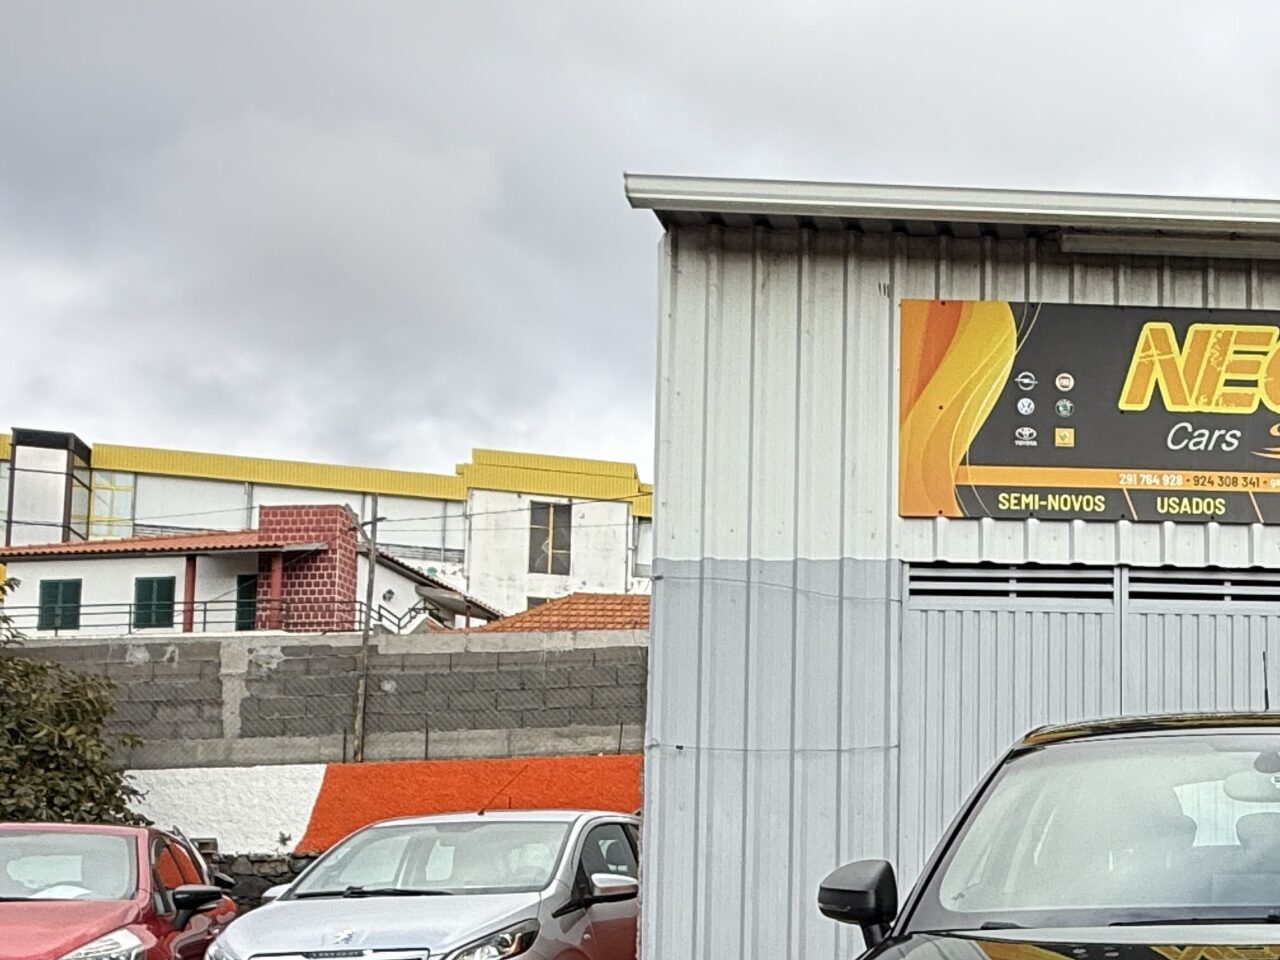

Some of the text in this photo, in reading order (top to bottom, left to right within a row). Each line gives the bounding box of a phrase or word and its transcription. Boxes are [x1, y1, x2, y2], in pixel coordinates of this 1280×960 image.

[1167, 422, 1241, 451] Cars
[1119, 473, 1137, 485] 291
[1139, 473, 1160, 486] 764
[1162, 474, 1183, 486] 928
[1193, 475, 1214, 487] 924
[1217, 476, 1238, 488] 308
[1241, 476, 1260, 488] 341
[998, 493, 1105, 512] SEMI-NOVOS
[1157, 497, 1226, 514] USADOS
